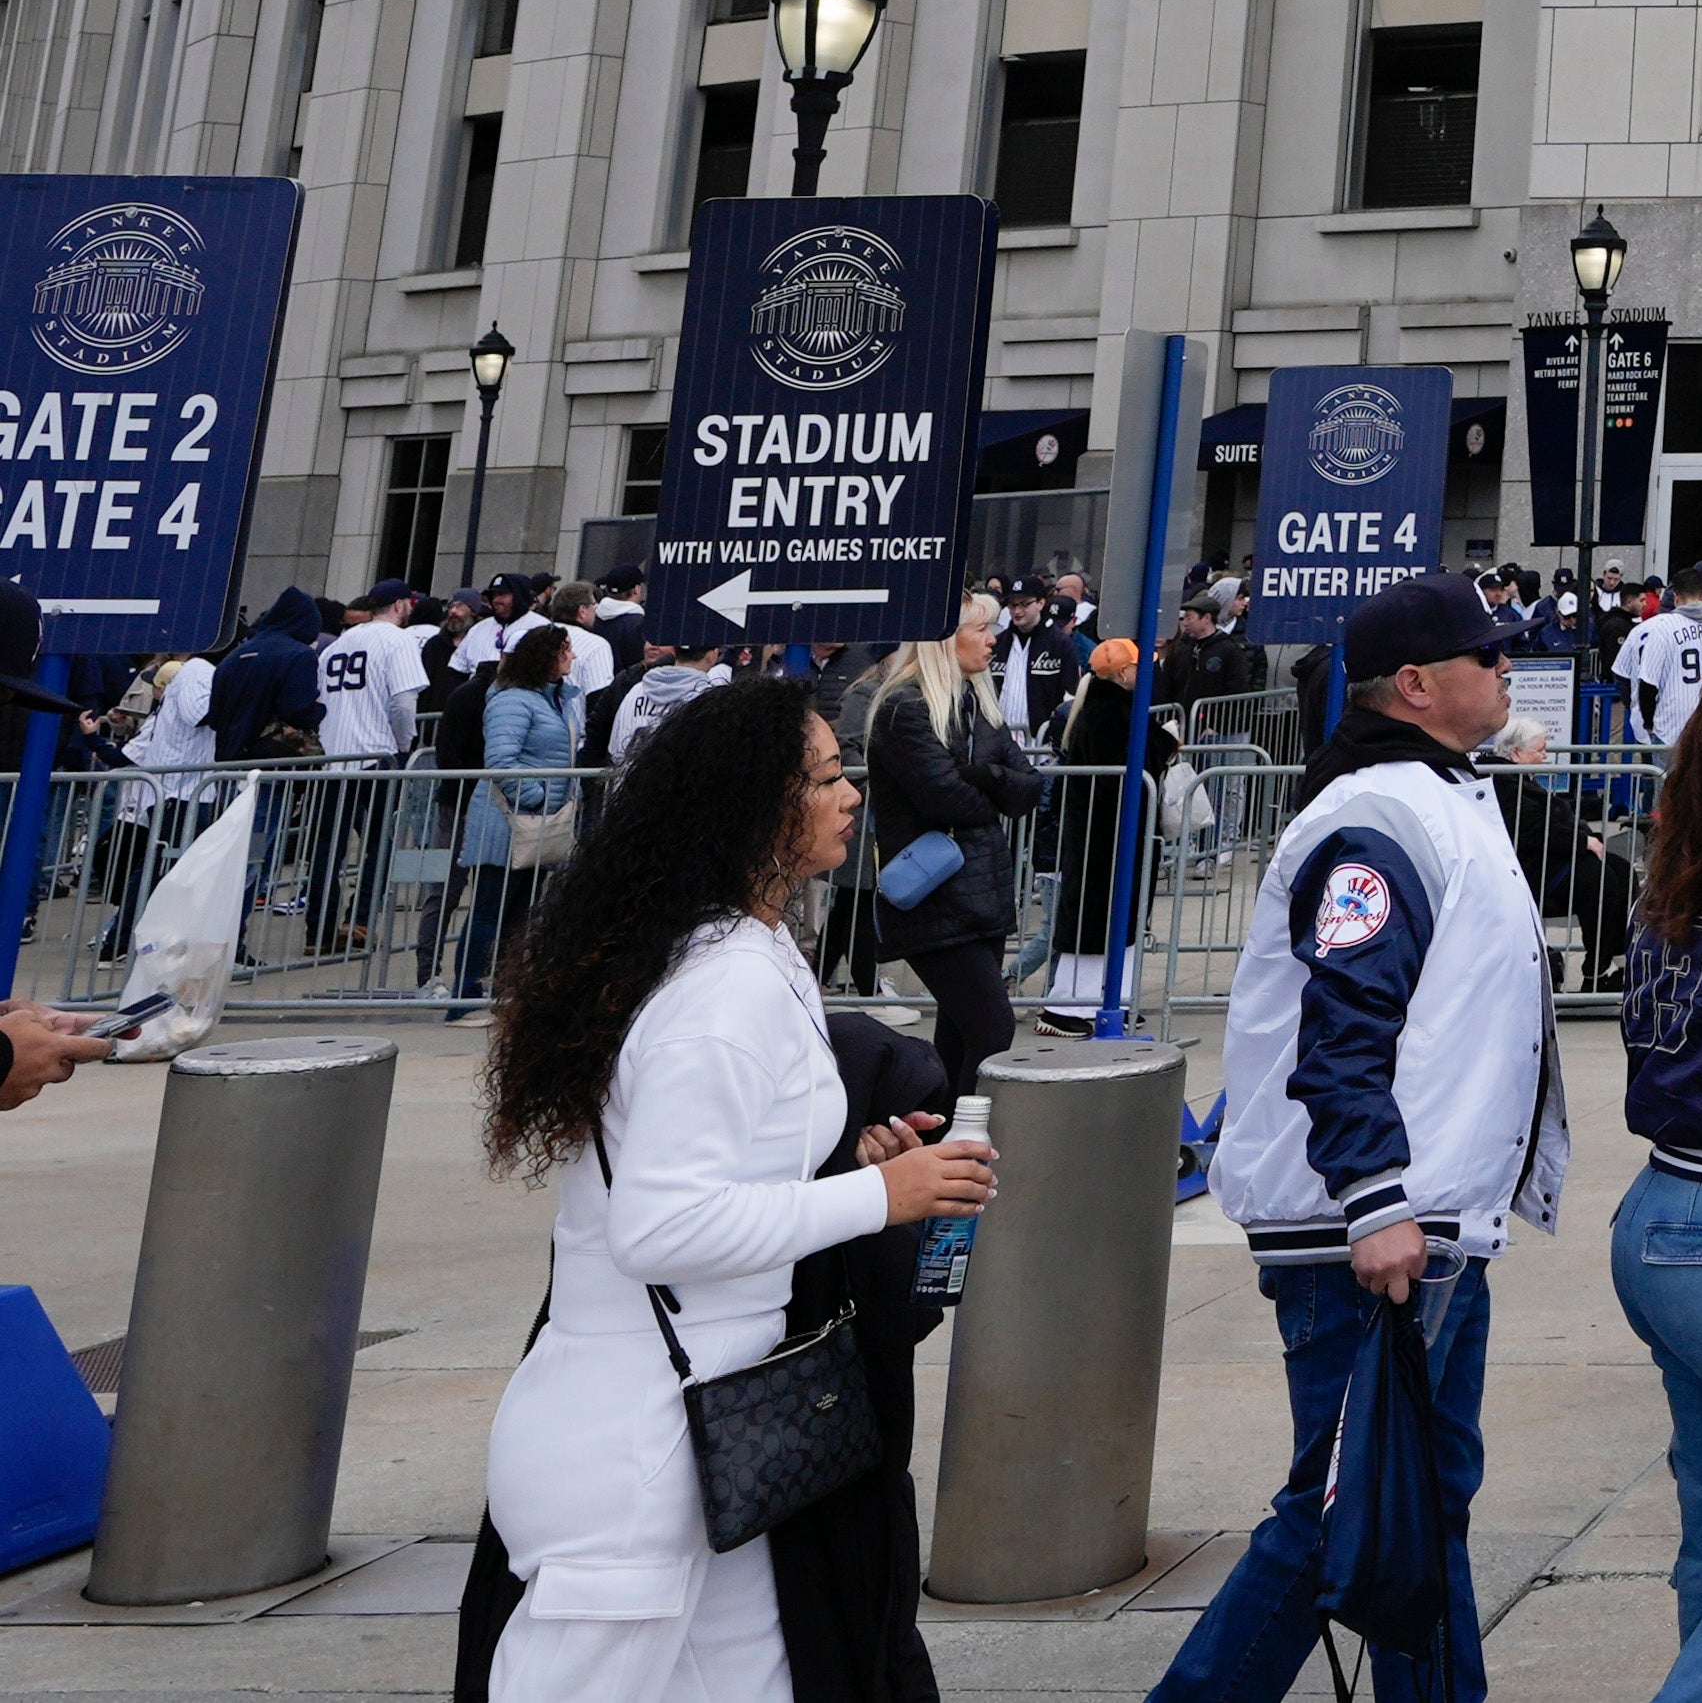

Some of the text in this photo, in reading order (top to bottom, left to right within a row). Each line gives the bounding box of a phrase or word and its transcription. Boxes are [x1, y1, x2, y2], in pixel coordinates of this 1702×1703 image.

[61, 215, 192, 254] YANKEE
[772, 238, 891, 275] YANKEE
[1526, 306, 1666, 328] YANKEE STADIUM
[45, 318, 180, 365] STADIUM
[762, 339, 885, 381] STADIUM
[1534, 368, 1579, 378] METRO NORTH
[1546, 356, 1579, 366] RIVER AVE
[1607, 351, 1652, 369] GATE 6
[1557, 379, 1578, 389] FERRY
[1606, 382, 1638, 392] YANKEES
[1607, 369, 1659, 380] HARD ROCK CAFE
[1321, 390, 1397, 415] YANKEE
[1606, 392, 1648, 402] TEAM STORE
[1606, 404, 1635, 414] SUBWAY
[170, 393, 219, 462] 2
[693, 412, 934, 467] STADIUM
[1214, 444, 1258, 463] SUITE
[1316, 451, 1393, 480] STADIUM
[2, 480, 201, 550] ATE 4
[727, 475, 906, 528] ENTRY
[1277, 511, 1383, 554] GATE
[1393, 512, 1418, 553] 4
[658, 537, 946, 565] WITH VALID GAMES TICKET
[1261, 566, 1349, 598] ENTER
[326, 650, 368, 693] 99
